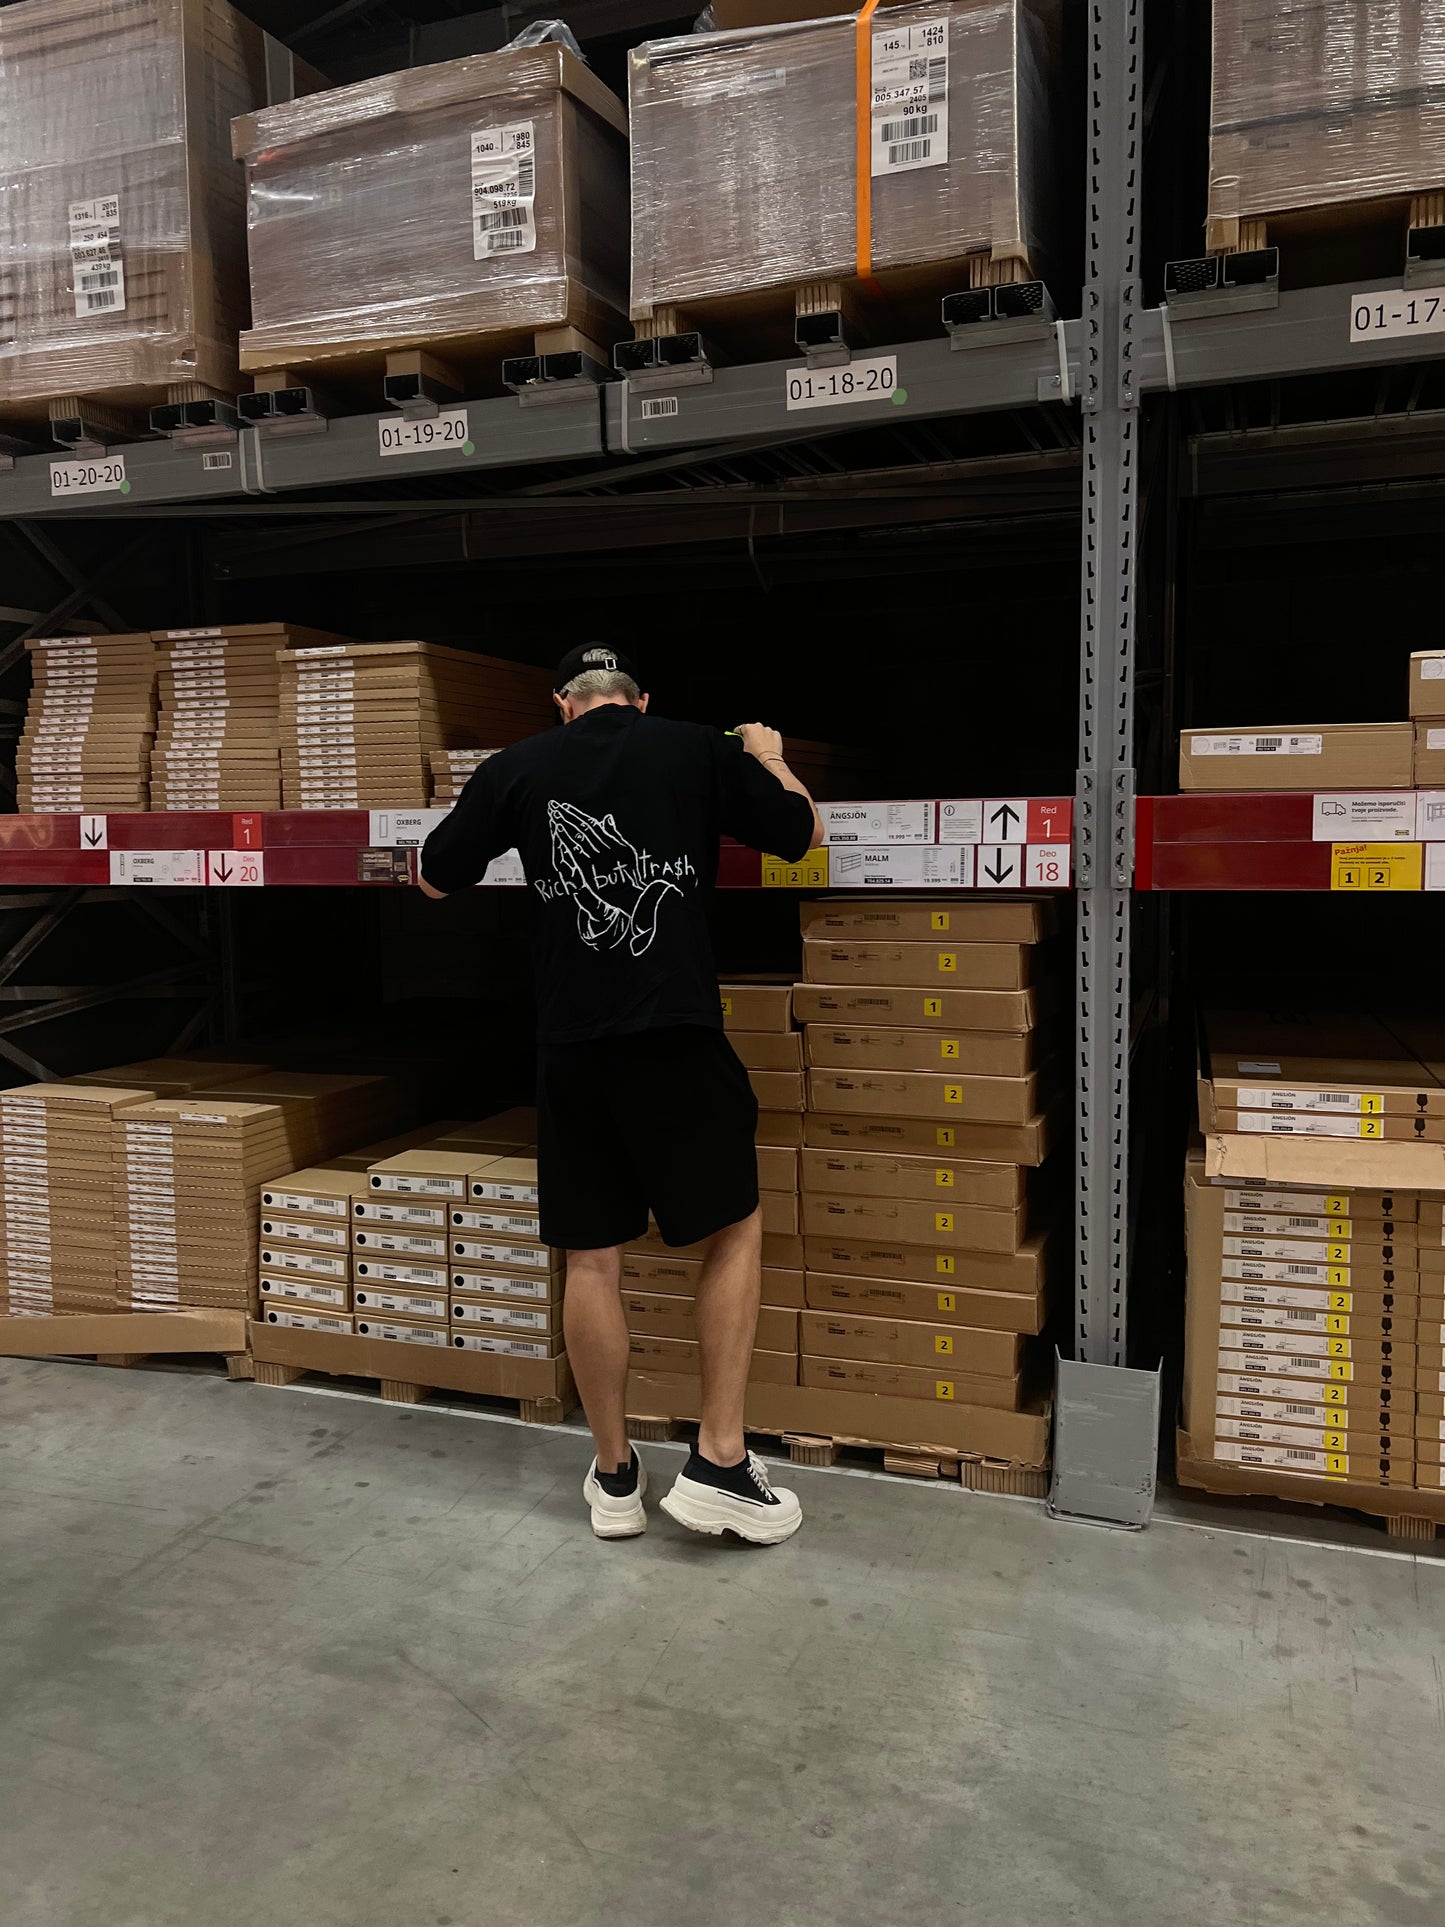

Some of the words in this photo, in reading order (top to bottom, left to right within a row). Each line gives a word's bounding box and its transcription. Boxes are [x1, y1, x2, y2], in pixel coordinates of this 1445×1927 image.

[922, 26, 944, 38] 1424
[884, 41, 900, 51] 145
[927, 36, 944, 46] 810
[875, 86, 924, 102] 005.347.57
[909, 94, 926, 104] 2405
[904, 106, 914, 115] 90
[916, 105, 927, 114] kg
[512, 132, 530, 142] 1980
[476, 143, 493, 153] 1040
[516, 140, 530, 149] 845
[494, 200, 507, 208] 519
[1354, 298, 1445, 330] 01-17
[790, 368, 892, 400] 01-18-20
[382, 420, 465, 447] 01-19-20
[53, 464, 123, 488] 01-20-20
[1040, 806, 1057, 814] Red
[1042, 819, 1051, 838] 1
[243, 828, 250, 845] 1
[1335, 844, 1367, 855] Pažnja!
[240, 866, 258, 882] 20
[770, 872, 775, 881] 1
[792, 872, 798, 881] 2
[813, 872, 819, 881] 3
[1036, 862, 1059, 881] 18
[534, 871, 577, 902] Rich
[592, 861, 628, 890] but
[1345, 872, 1354, 883] 1
[1374, 872, 1384, 883] 2
[937, 916, 943, 926] 1
[944, 958, 951, 967] 2
[930, 1002, 935, 1012] 1
[947, 1045, 953, 1054] 2
[950, 1090, 957, 1099] 2
[1368, 1100, 1373, 1110] 1
[1367, 1123, 1374, 1133] 2
[942, 1132, 948, 1142] 1
[942, 1173, 948, 1182] 2
[1333, 1201, 1341, 1210] 2
[942, 1218, 948, 1227] 2
[1336, 1225, 1342, 1234] 1
[1334, 1249, 1342, 1258] 2
[942, 1259, 948, 1269] 1
[1335, 1273, 1340, 1282] 1
[943, 1297, 949, 1307] 1
[1337, 1297, 1344, 1306] 2
[1334, 1319, 1339, 1328] 1
[941, 1340, 947, 1350] 2
[1335, 1343, 1343, 1353] 2
[1338, 1367, 1343, 1376] 1
[942, 1386, 948, 1395] 2
[1331, 1390, 1339, 1399] 2
[1333, 1414, 1338, 1423] 1
[1331, 1437, 1339, 1446] 2
[1333, 1459, 1338, 1468] 1
